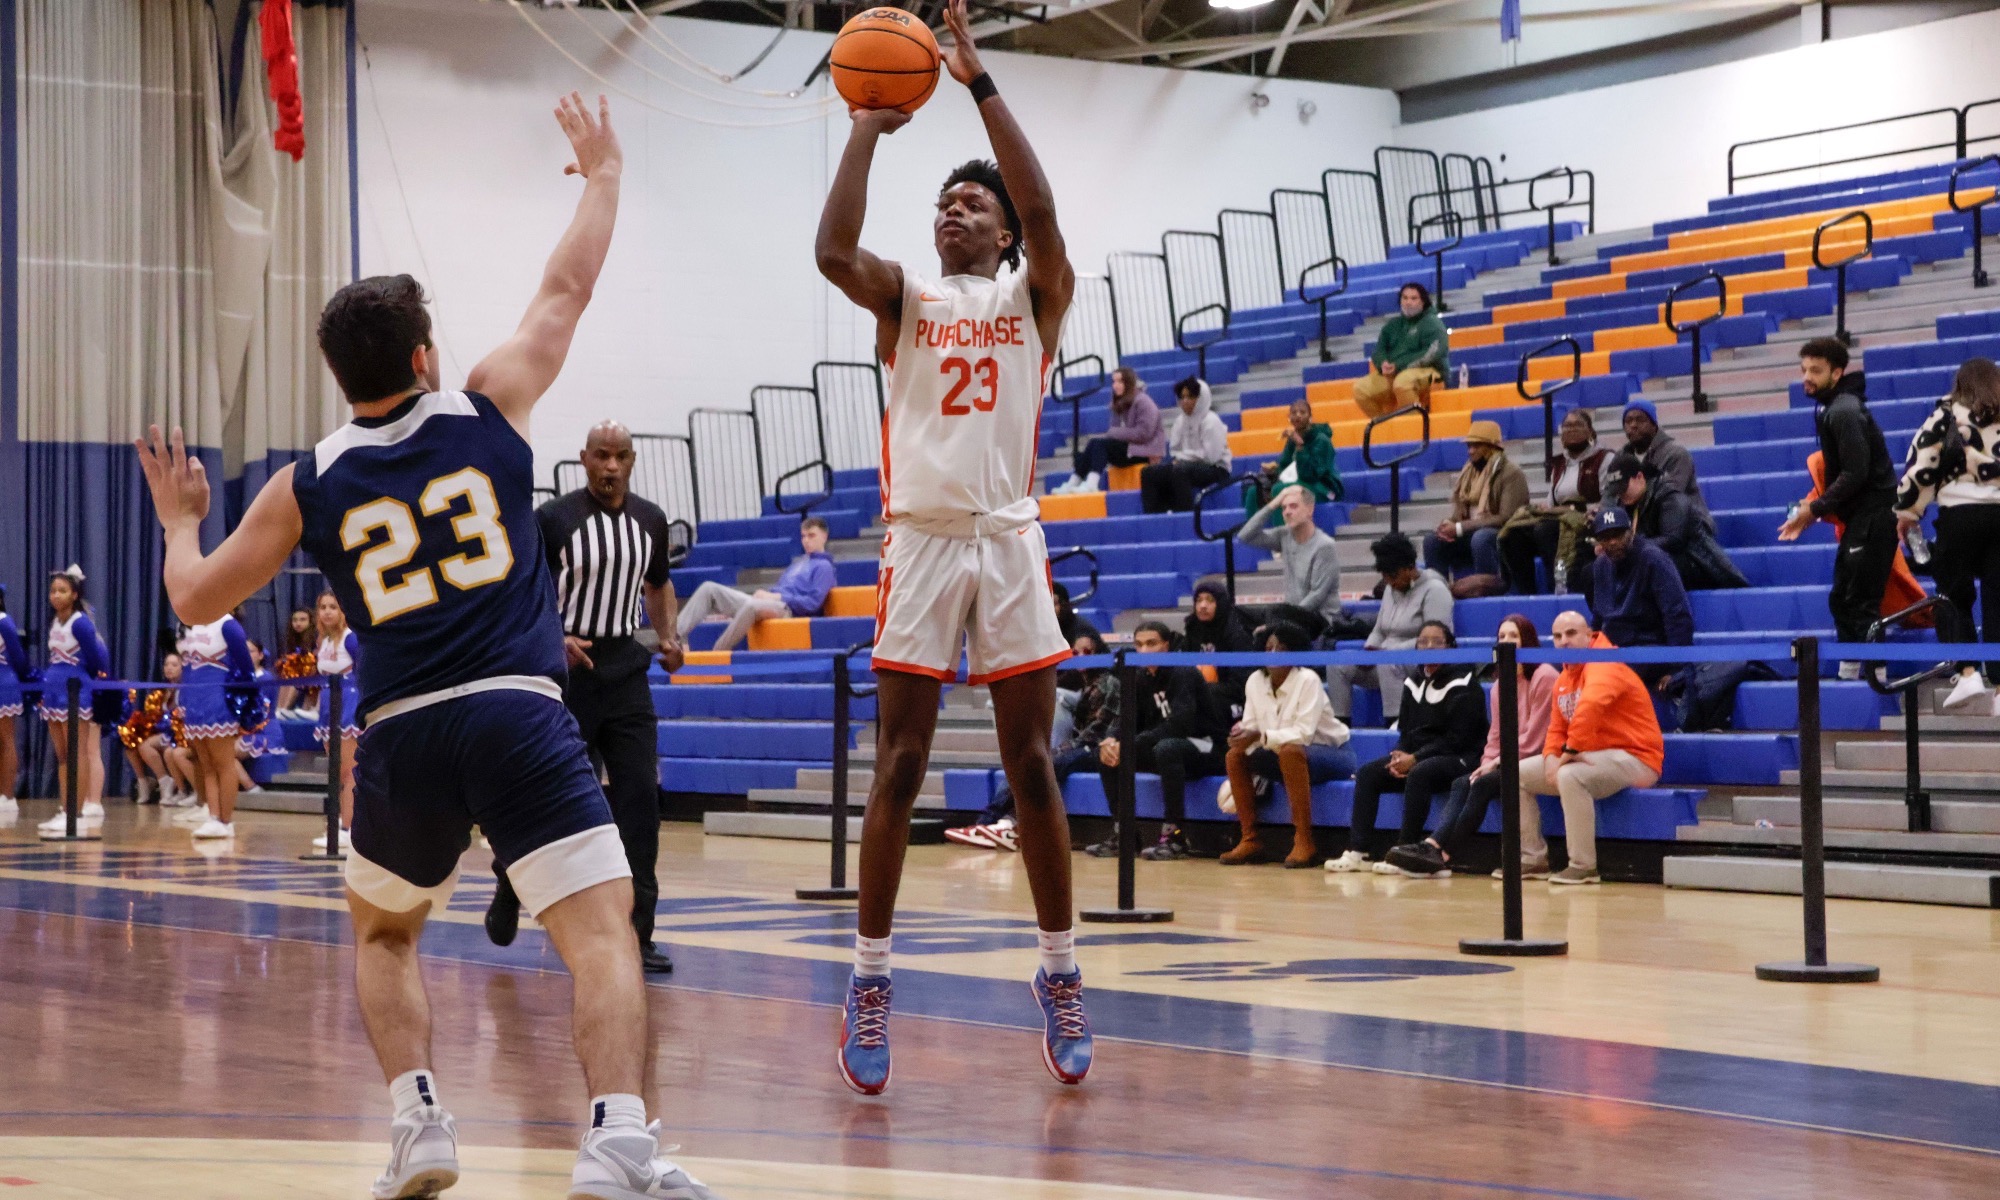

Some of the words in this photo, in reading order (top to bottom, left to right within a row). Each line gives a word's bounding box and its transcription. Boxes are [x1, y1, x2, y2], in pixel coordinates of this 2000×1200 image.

[857, 9, 910, 28] NCAA
[915, 316, 1024, 348] PURCHASE
[940, 357, 999, 416] 23
[338, 465, 515, 626] 23
